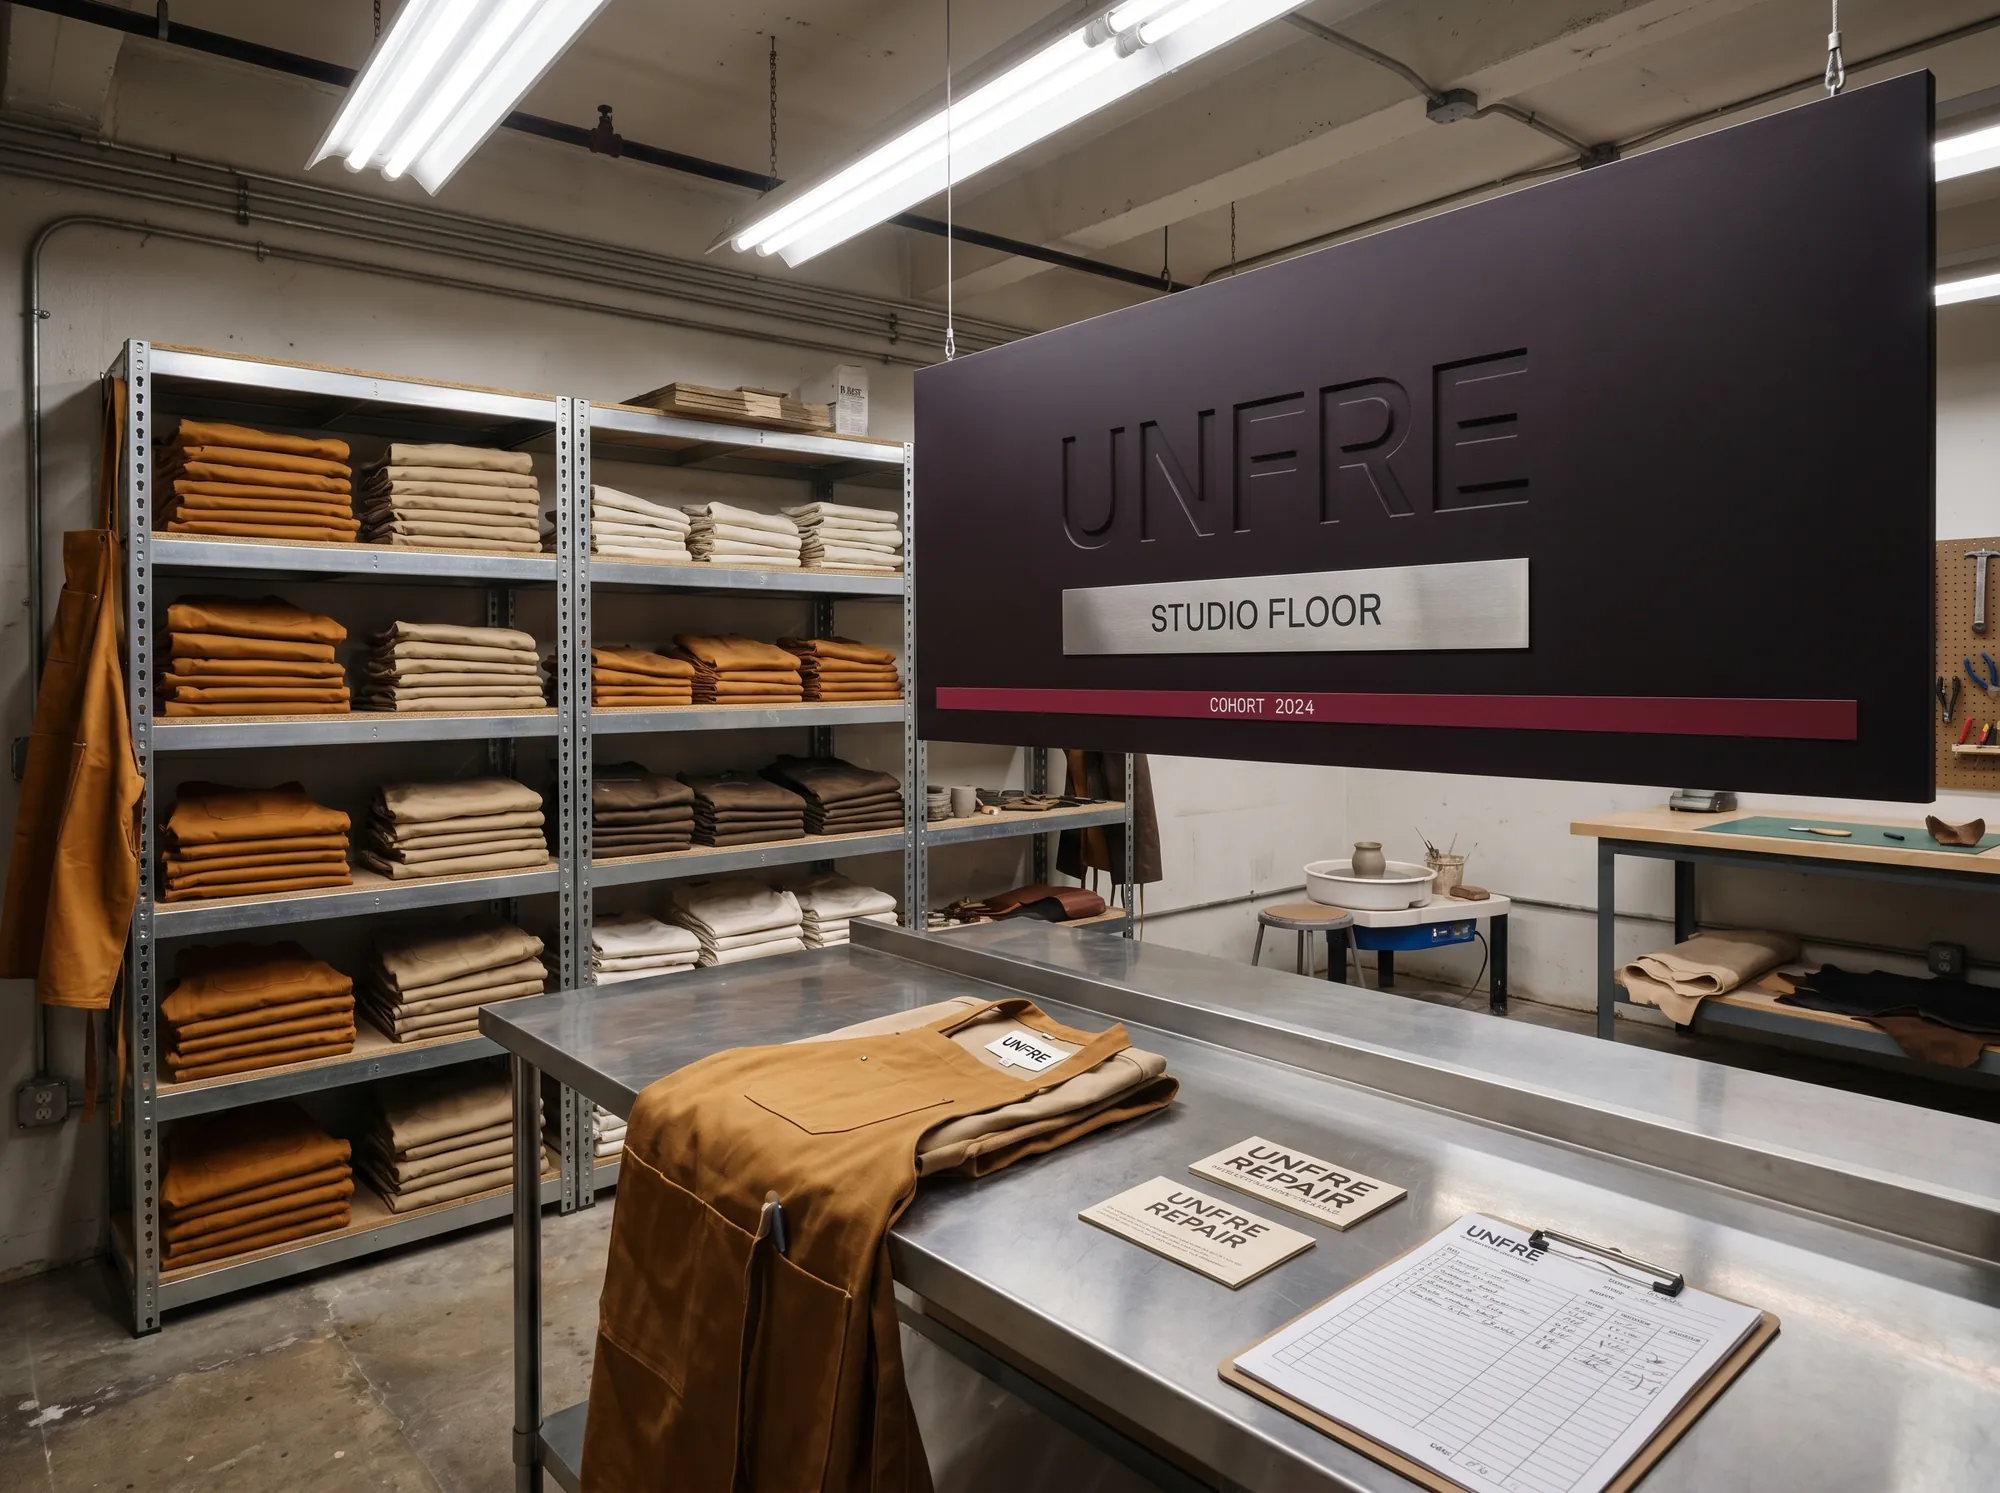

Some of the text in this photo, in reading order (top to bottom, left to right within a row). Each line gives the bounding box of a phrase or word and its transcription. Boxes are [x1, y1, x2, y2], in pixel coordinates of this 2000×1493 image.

[1062, 347, 1530, 549] UNFRE
[1152, 594, 1382, 632] STUDIO FLOOR
[1210, 697, 1315, 715] COHORT 2024
[1002, 1036, 1052, 1063] UNFRE
[1223, 1156, 1356, 1209] REPAIR
[1247, 1145, 1379, 1198] UNFRE
[1143, 1201, 1248, 1249] REPAIR
[1166, 1191, 1270, 1239] UNFRE
[1466, 1224, 1545, 1262] UNFRE
